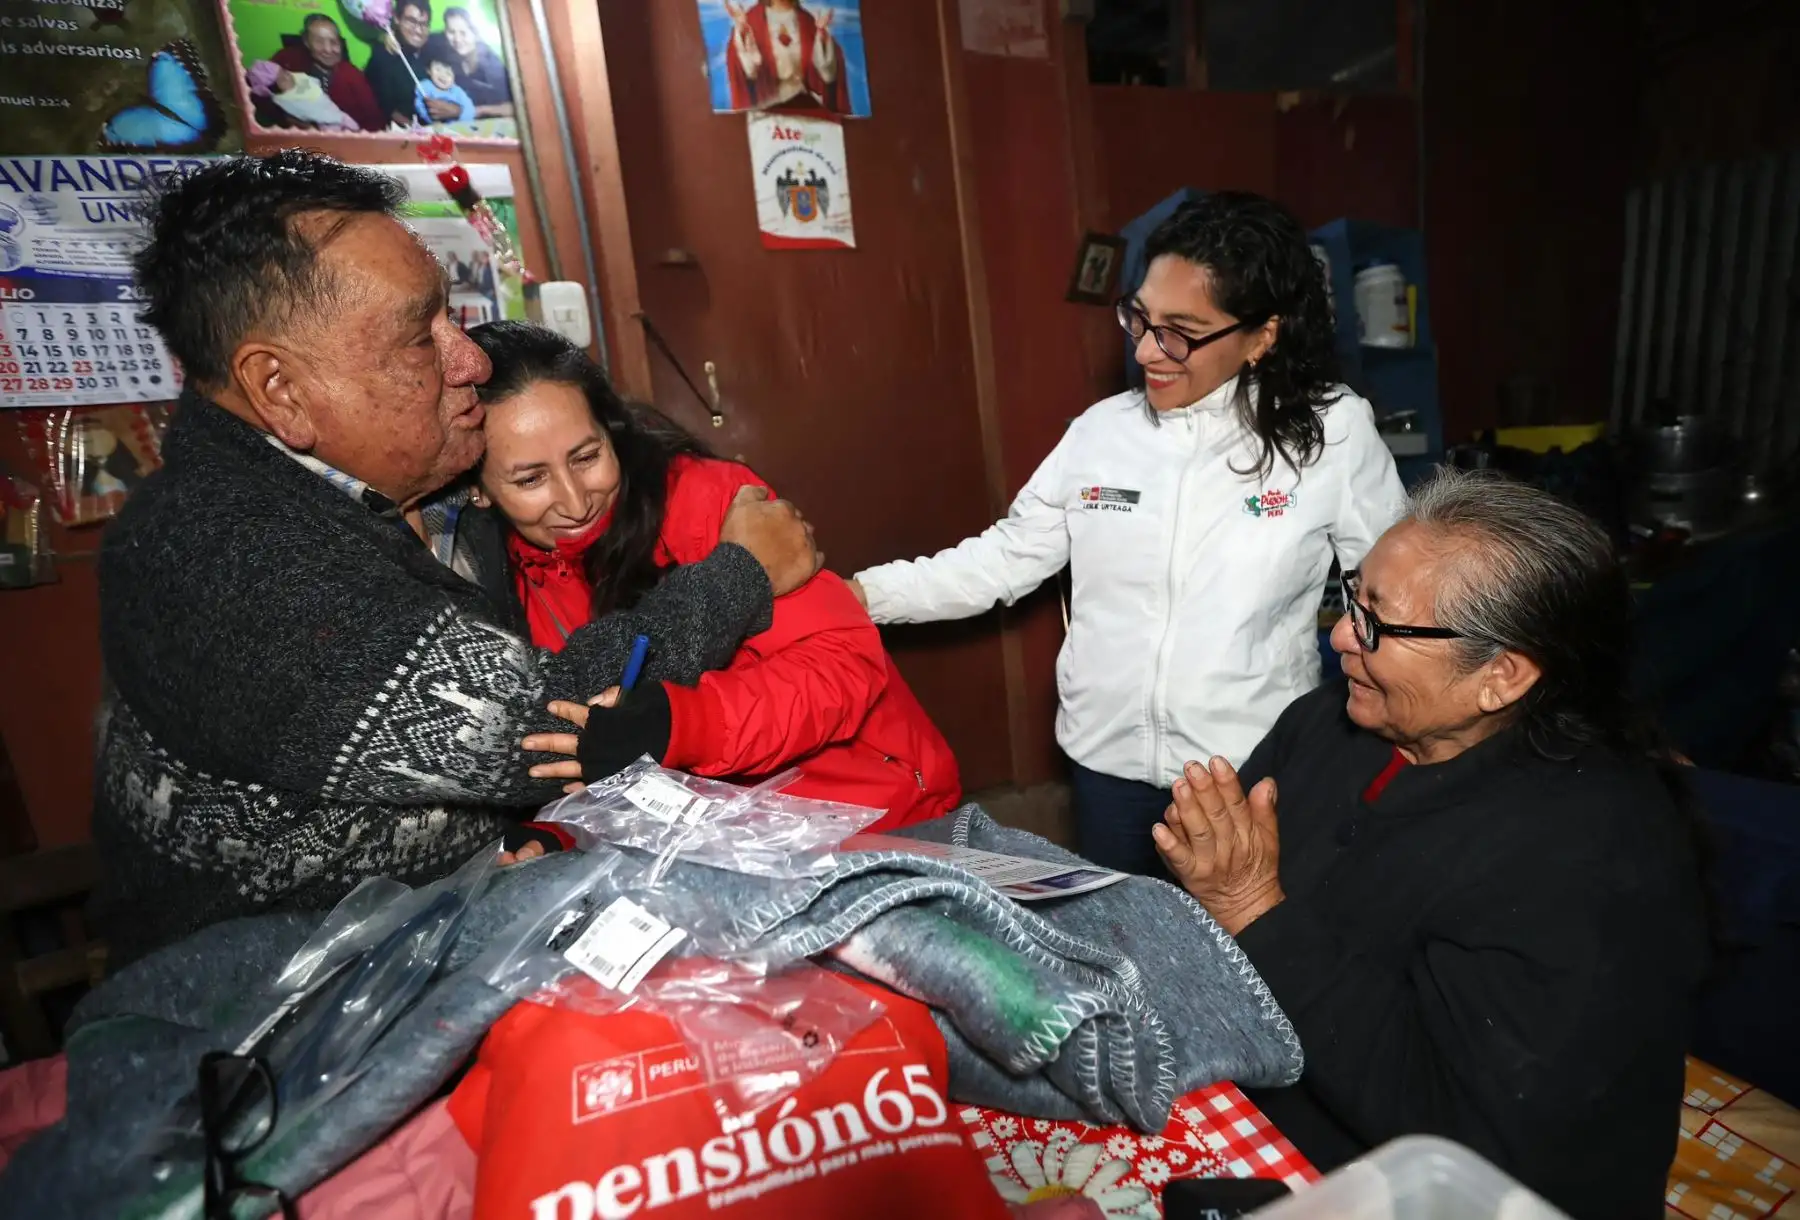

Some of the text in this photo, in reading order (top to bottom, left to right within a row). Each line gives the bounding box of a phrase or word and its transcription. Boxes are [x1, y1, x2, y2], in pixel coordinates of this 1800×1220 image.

[20, 14, 79, 31] salvas
[22, 41, 143, 60] adversarios!
[39, 98, 71, 108] 22:4
[772, 125, 801, 140] Ate
[37, 312, 46, 324] 1
[62, 312, 76, 324] 2
[86, 312, 98, 324] 3
[16, 328, 28, 341] 7
[42, 328, 54, 341] 8
[67, 328, 79, 341] 9
[86, 328, 106, 341] 10
[112, 328, 128, 341] 11
[134, 328, 152, 340] 12
[17, 345, 39, 357] 14
[43, 345, 63, 357] 15
[67, 345, 88, 357] 16
[91, 345, 109, 357] 17
[115, 344, 134, 356] 18
[138, 343, 155, 355] 19
[0, 359, 162, 374] 20 21 22 23 24 25 26
[1, 376, 119, 391] 27 28 29 30 31
[820, 1151, 858, 1176] para
[861, 1140, 895, 1161] más
